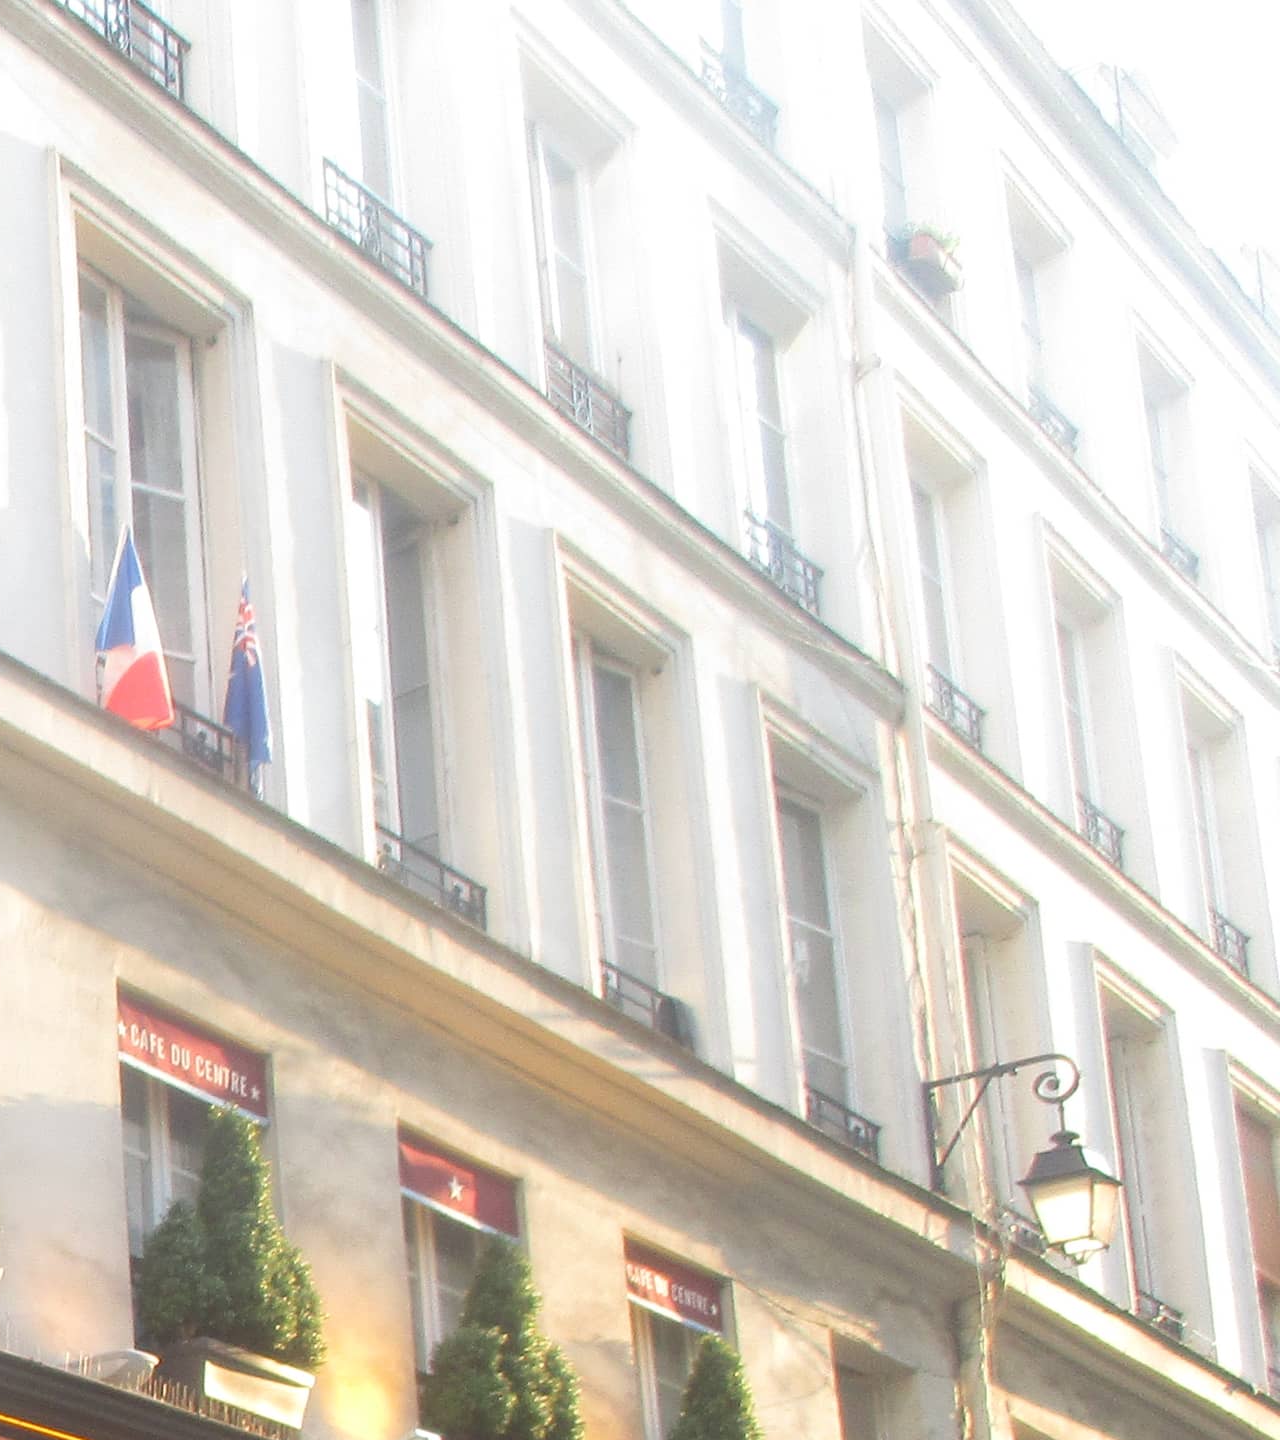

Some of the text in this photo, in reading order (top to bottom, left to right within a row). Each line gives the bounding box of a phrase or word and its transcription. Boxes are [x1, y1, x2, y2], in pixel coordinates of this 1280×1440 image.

[129, 1023, 248, 1097] CAFE DU CENTRE
[671, 1282, 709, 1314] CENTRE
